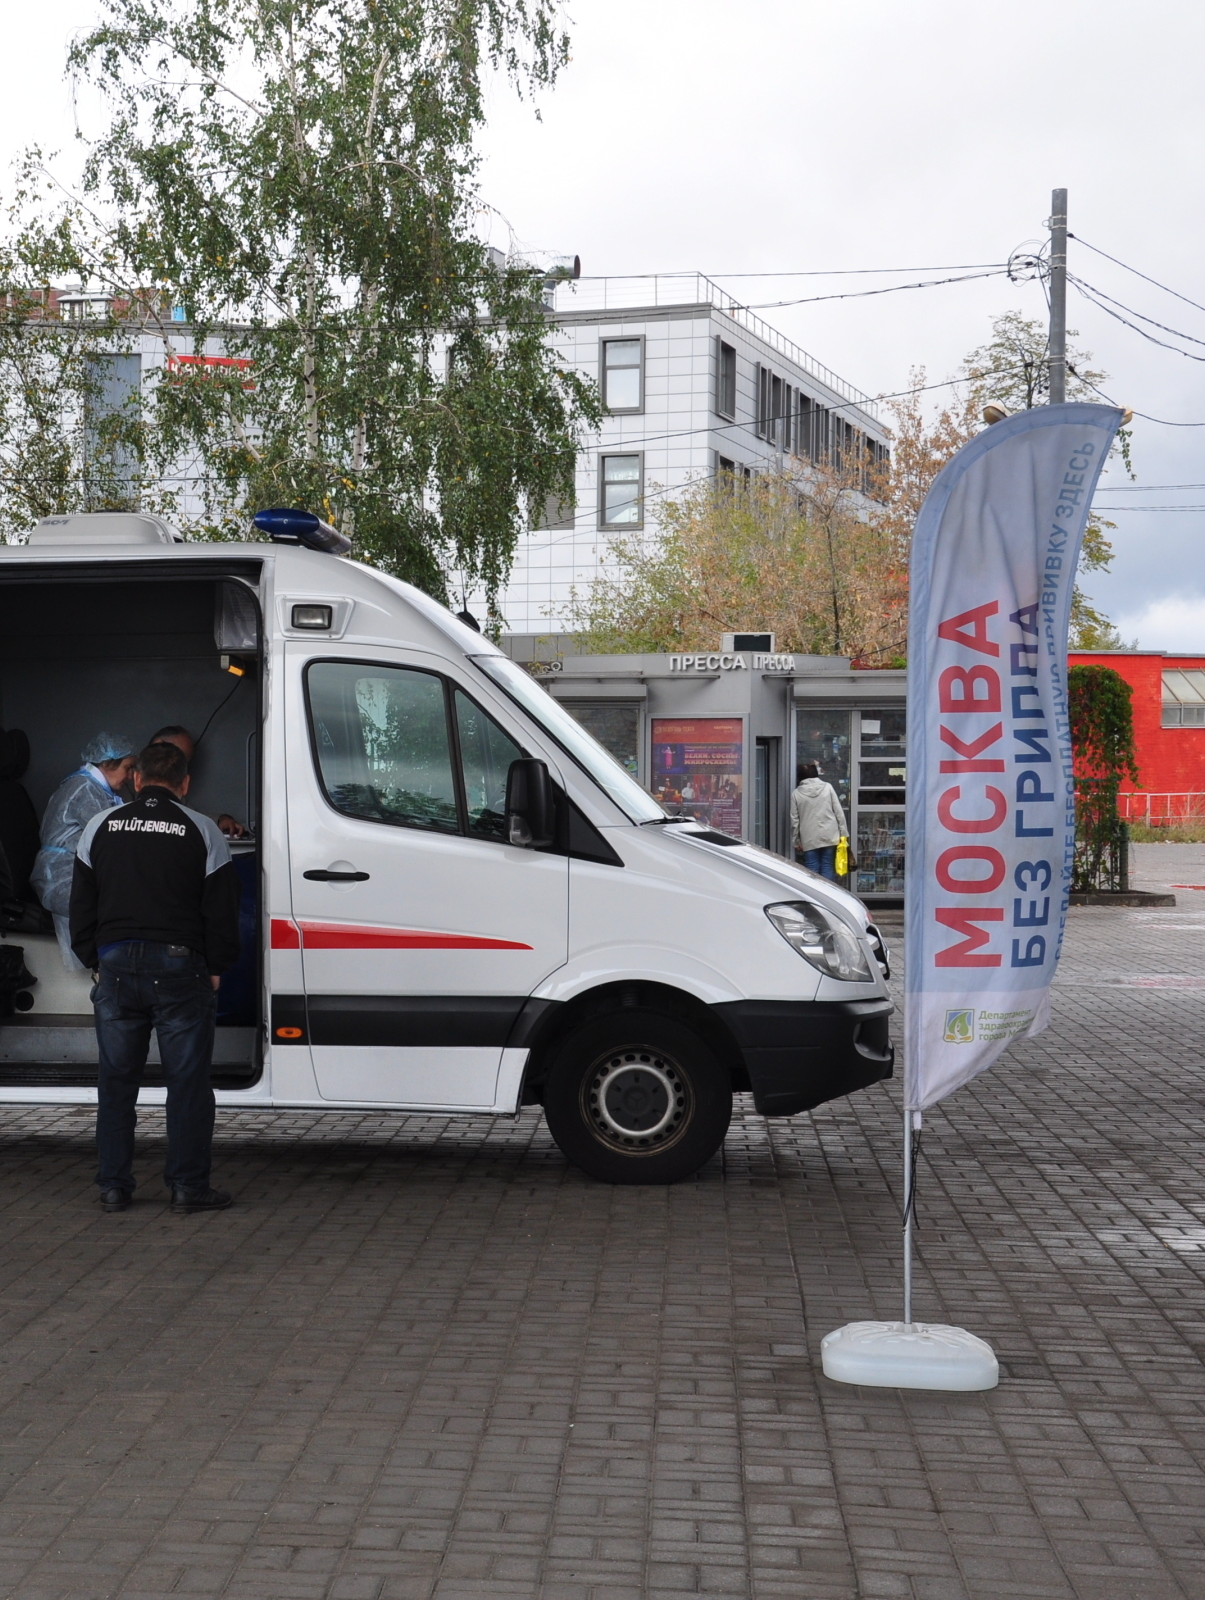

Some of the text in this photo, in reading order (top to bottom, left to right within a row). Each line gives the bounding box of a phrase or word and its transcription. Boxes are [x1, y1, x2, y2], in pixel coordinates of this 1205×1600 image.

[1054, 441, 1095, 519] ЗДЕСЬ
[1042, 523, 1069, 656] ПРИВИВКУ
[670, 655, 795, 671] ПРЕССА ПРЕССА
[935, 600, 1007, 967] МОСКВА
[1009, 602, 1054, 967] БЕЗ ГРИППА
[108, 817, 186, 836] TSV LÜTJENBURG
[978, 1009, 1031, 1021] Департамент
